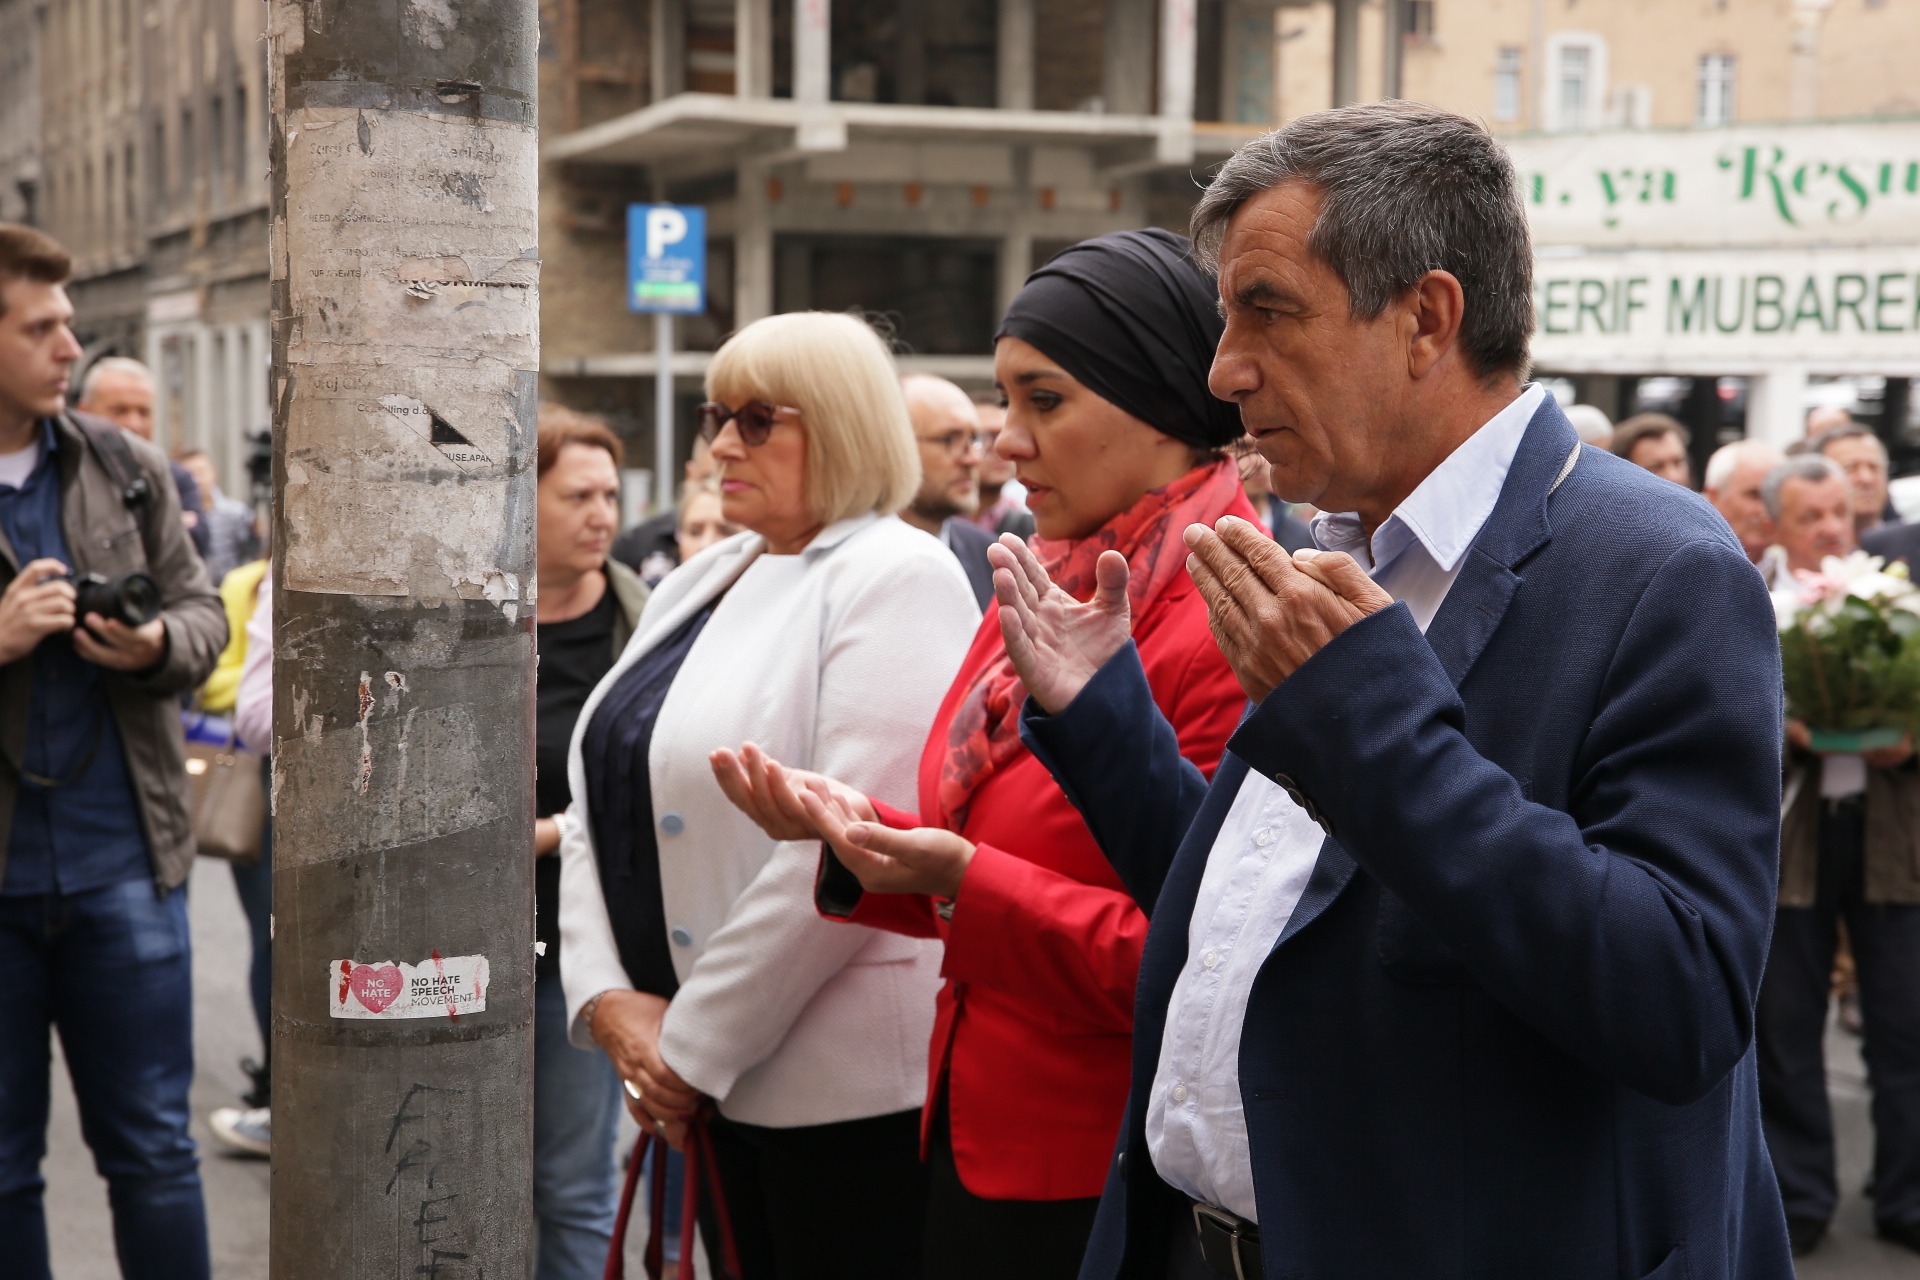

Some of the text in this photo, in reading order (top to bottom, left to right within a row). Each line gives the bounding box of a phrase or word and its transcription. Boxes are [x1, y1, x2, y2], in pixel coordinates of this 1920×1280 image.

[1600, 168, 1677, 227] ya
[645, 207, 688, 259] P
[1534, 273, 1920, 335] ERIF MUBARE
[367, 979, 384, 987] NO
[411, 976, 461, 987] NO HATE
[361, 988, 391, 998] HATE
[411, 986, 455, 996] SPEECH
[411, 992, 473, 1007] MOVEMENT
